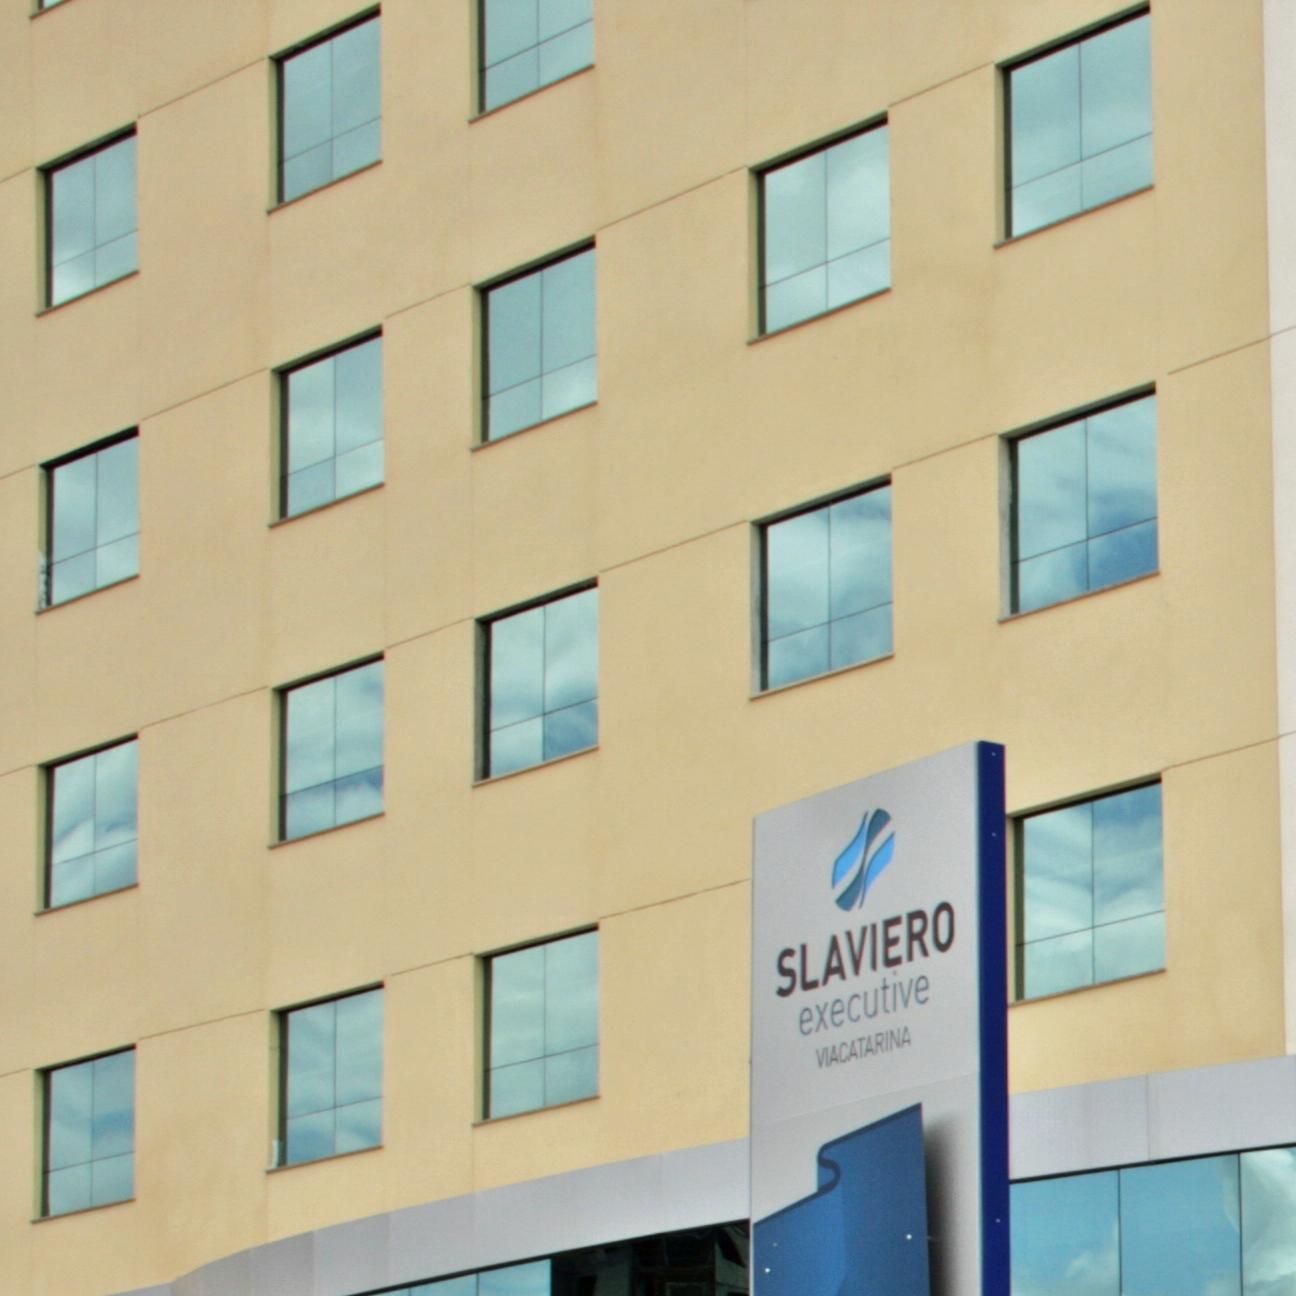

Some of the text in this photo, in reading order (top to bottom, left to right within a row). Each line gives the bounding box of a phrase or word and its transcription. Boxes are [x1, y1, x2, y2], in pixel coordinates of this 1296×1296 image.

[776, 901, 955, 998] SLAVIERO
[799, 969, 930, 1035] executive
[815, 1025, 912, 1068] VIACATARINA
